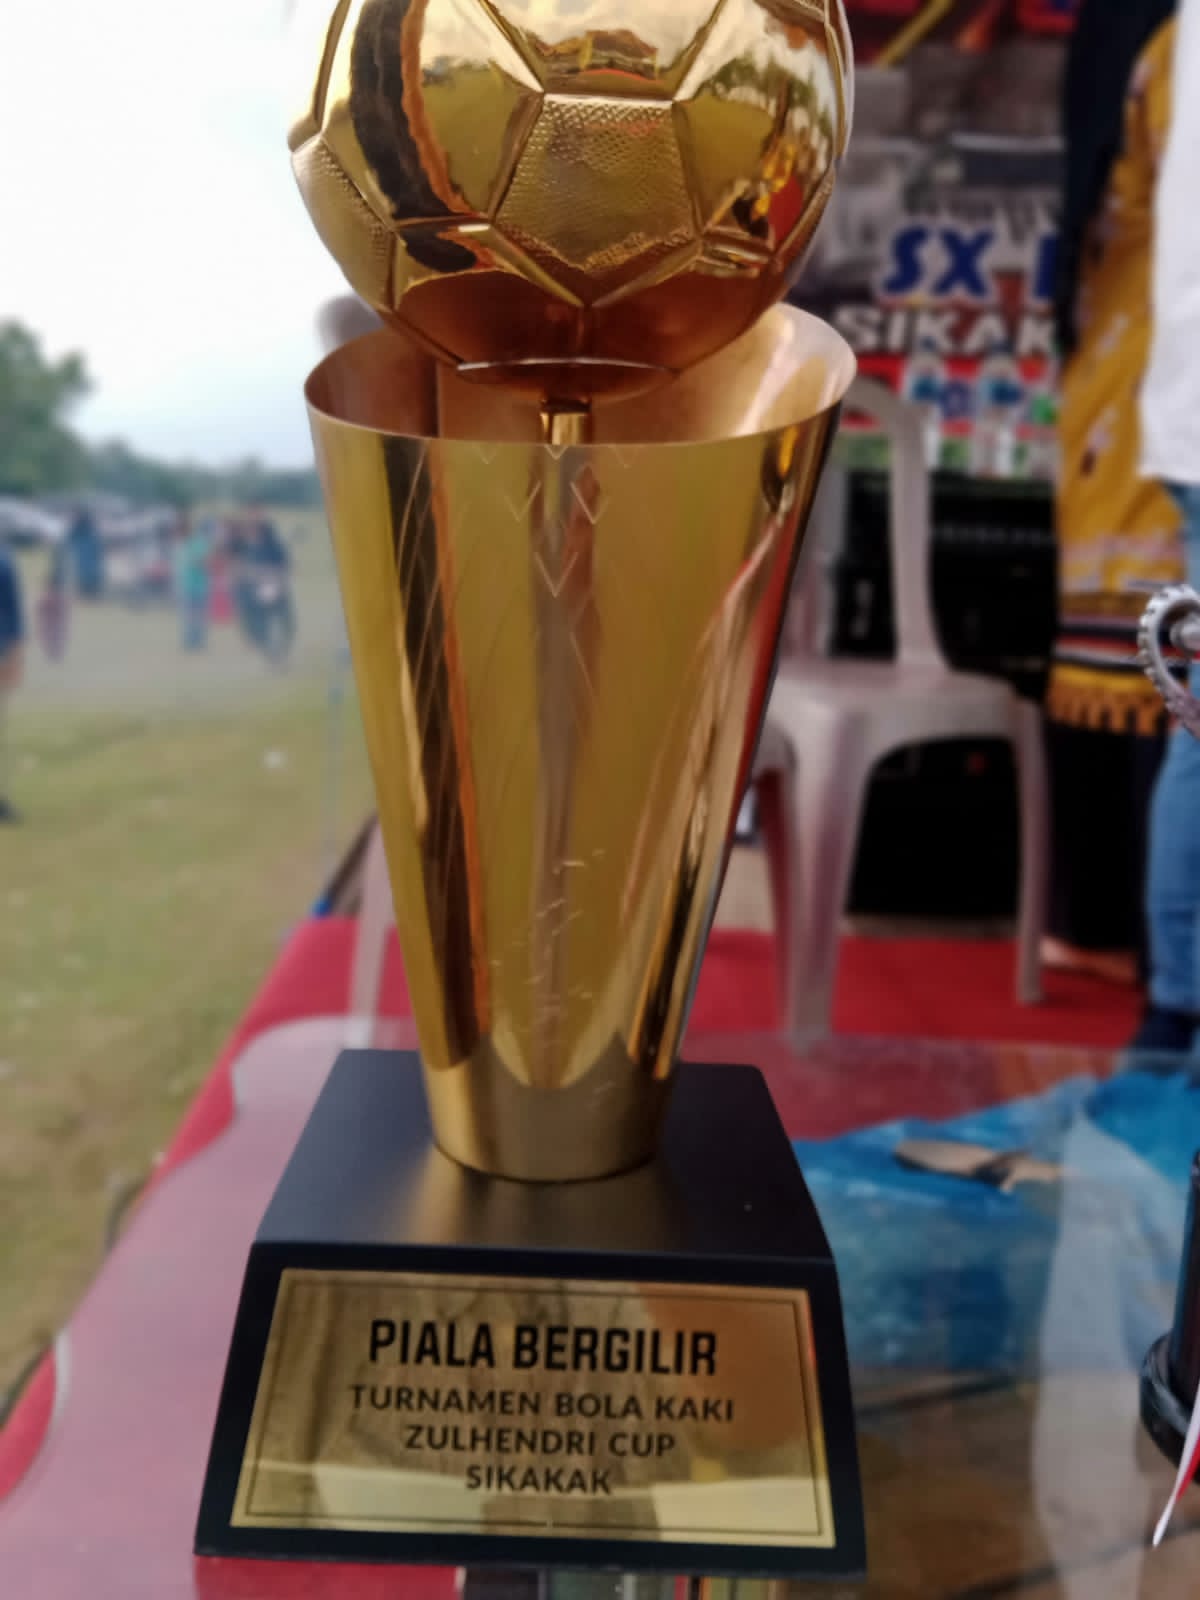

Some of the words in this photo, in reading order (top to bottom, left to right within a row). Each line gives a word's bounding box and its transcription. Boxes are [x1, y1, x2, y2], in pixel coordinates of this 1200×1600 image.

[369, 1319, 496, 1369] PIALA
[512, 1324, 717, 1376] BERGILIR
[351, 1384, 541, 1416] TURNAMEN
[555, 1391, 643, 1420] BOLA
[655, 1394, 735, 1423] KAKI
[404, 1424, 596, 1456] ZULHENDRI
[608, 1432, 676, 1457] CUP
[466, 1464, 611, 1496] SIKAKAK
